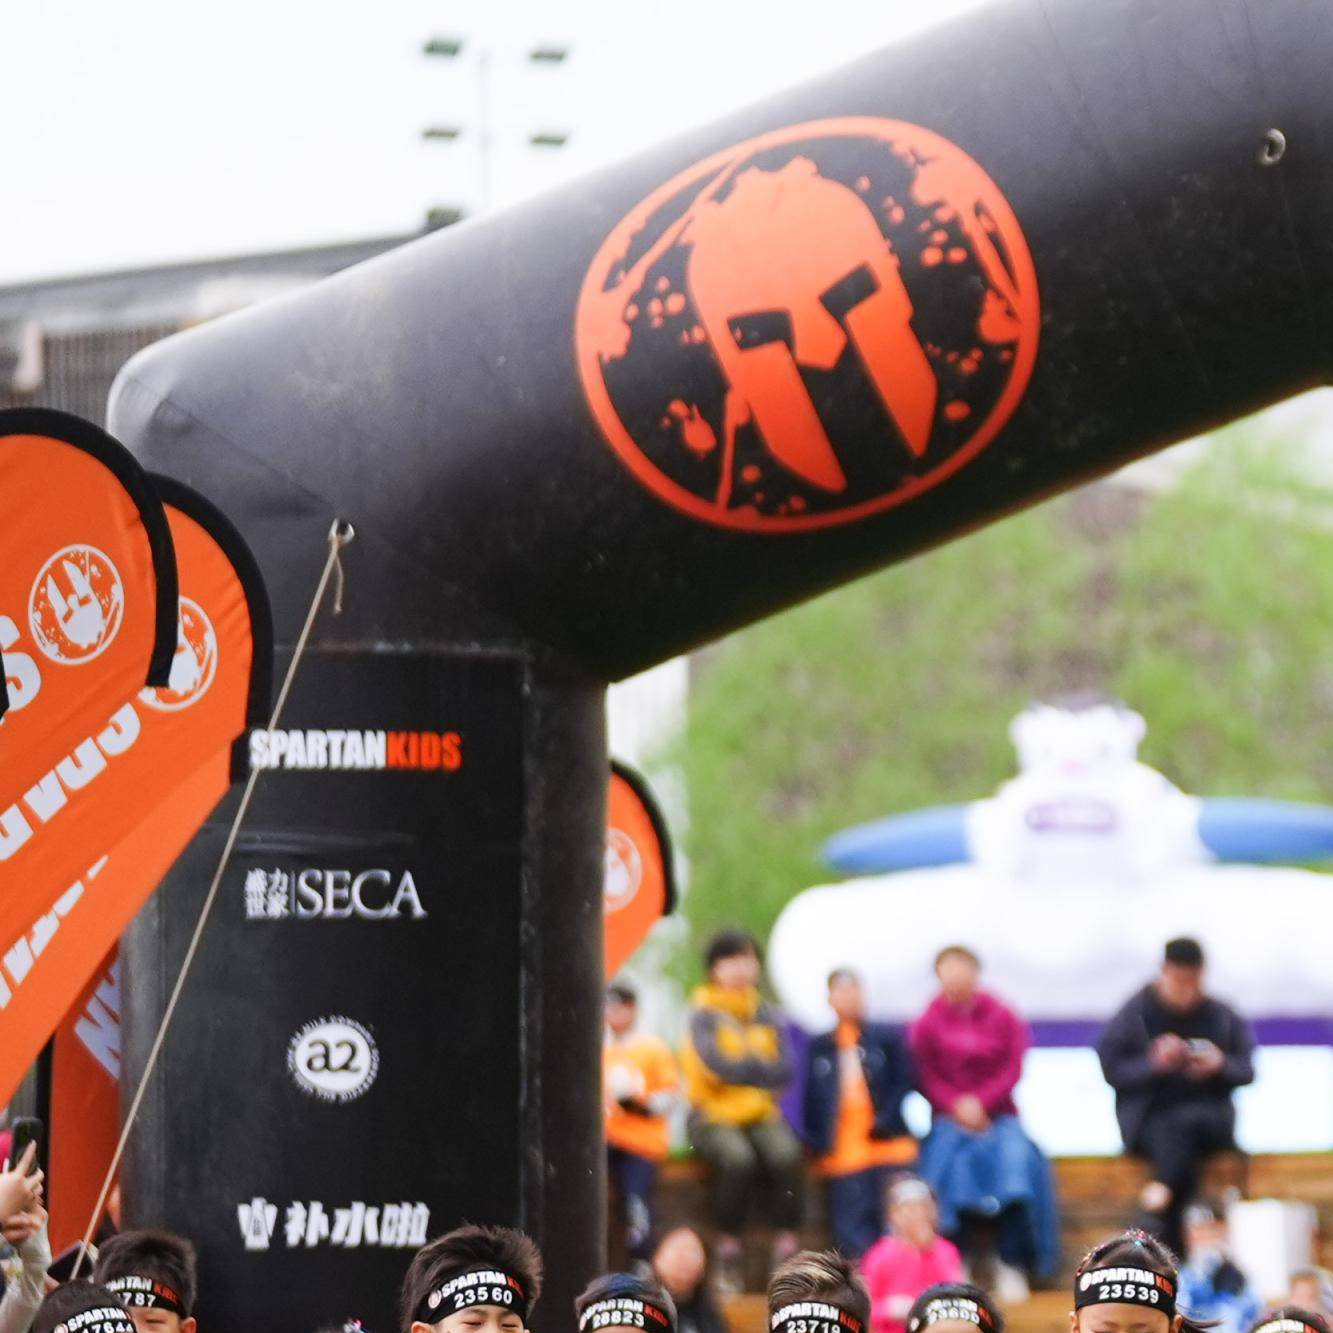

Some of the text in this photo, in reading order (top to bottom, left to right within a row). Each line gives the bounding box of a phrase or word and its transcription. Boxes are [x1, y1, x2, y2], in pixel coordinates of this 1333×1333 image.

[297, 869, 428, 920] SECA
[306, 1039, 362, 1073] a2
[283, 1200, 431, 1248] 补水啦
[440, 1270, 508, 1299] SPARTAN
[1090, 1267, 1155, 1286] SPARTAN
[117, 1291, 157, 1308] 787
[453, 1286, 514, 1309] 23560
[1098, 1284, 1160, 1304] 23539
[68, 1306, 126, 1333] SPARTAN
[585, 1297, 644, 1320] SPARTAN
[778, 1302, 840, 1323] SPARTAN
